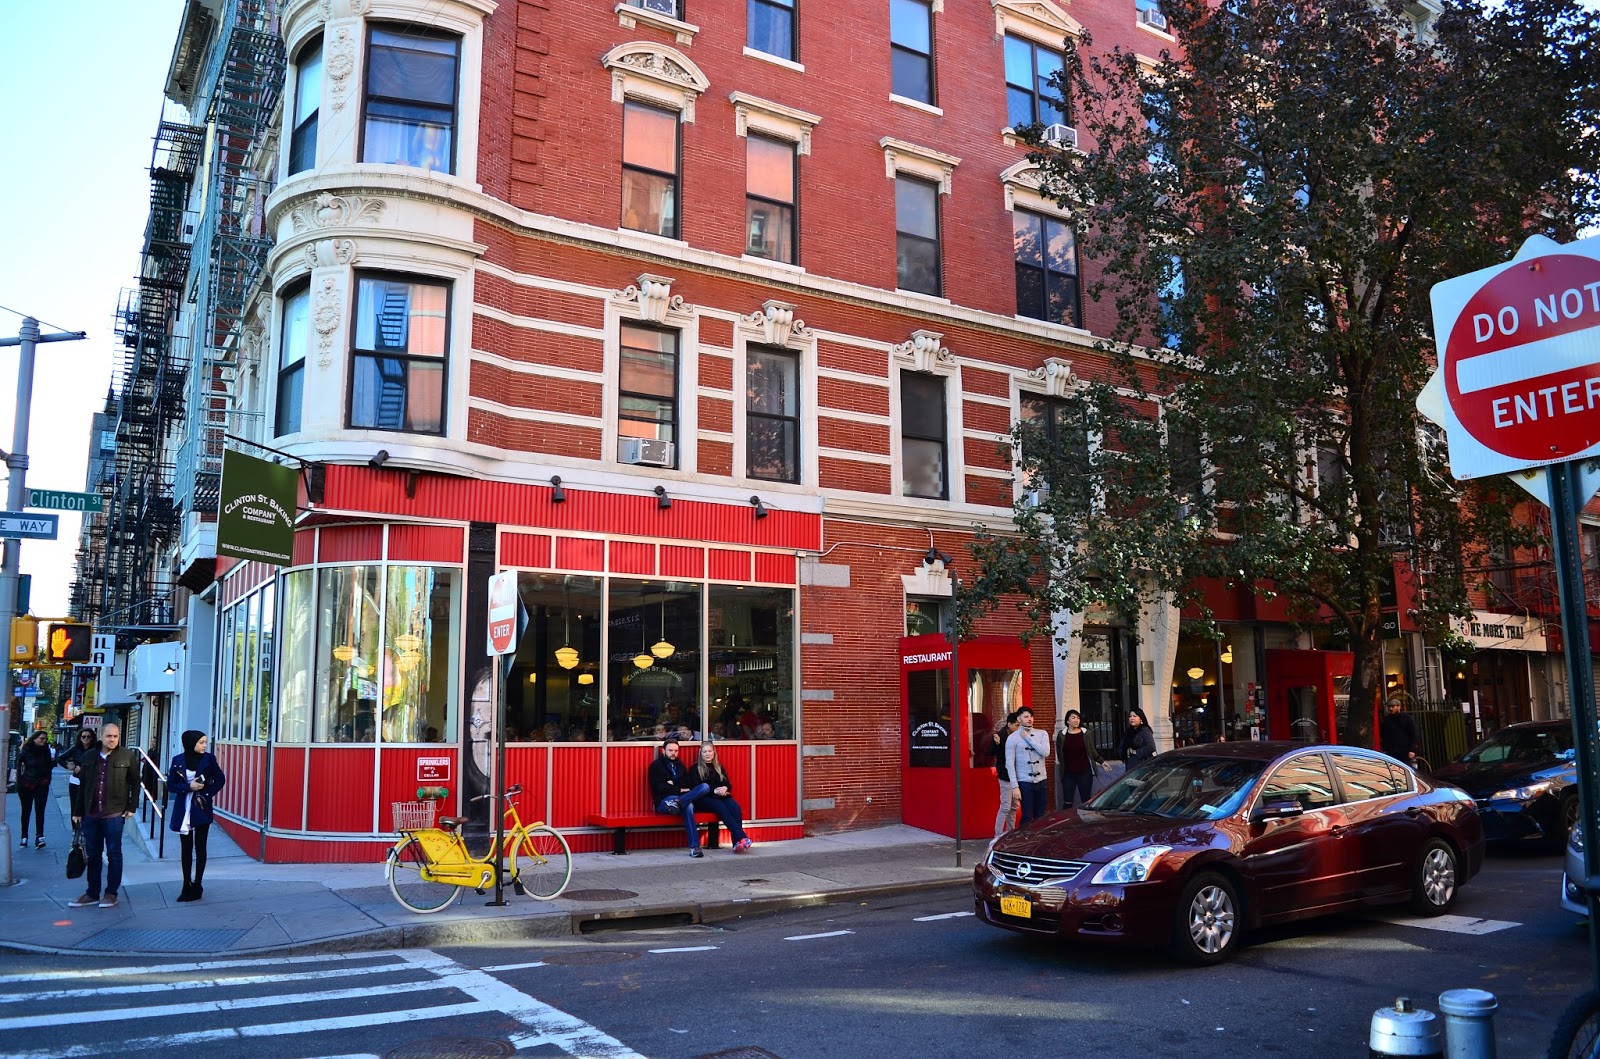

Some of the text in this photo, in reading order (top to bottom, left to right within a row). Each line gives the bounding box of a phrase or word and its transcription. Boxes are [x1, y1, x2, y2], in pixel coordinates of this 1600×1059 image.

[1472, 281, 1600, 343] DO NOT
[1492, 377, 1600, 429] ENTER
[30, 491, 101, 510] Clinton St
[224, 494, 292, 528] CLINTON ST. BAKING
[242, 506, 276, 520] COMPANY
[20, 520, 47, 532] WAY
[247, 514, 276, 524] RESTAURANT
[494, 624, 510, 638] ENTER
[1482, 624, 1504, 638] MORE
[1506, 626, 1524, 640] THAI
[903, 652, 952, 664] RESTAURANT
[626, 668, 650, 682] CLINTON
[662, 668, 682, 682] BAKING
[84, 716, 101, 725] ATM
[1252, 729, 1258, 738] A
